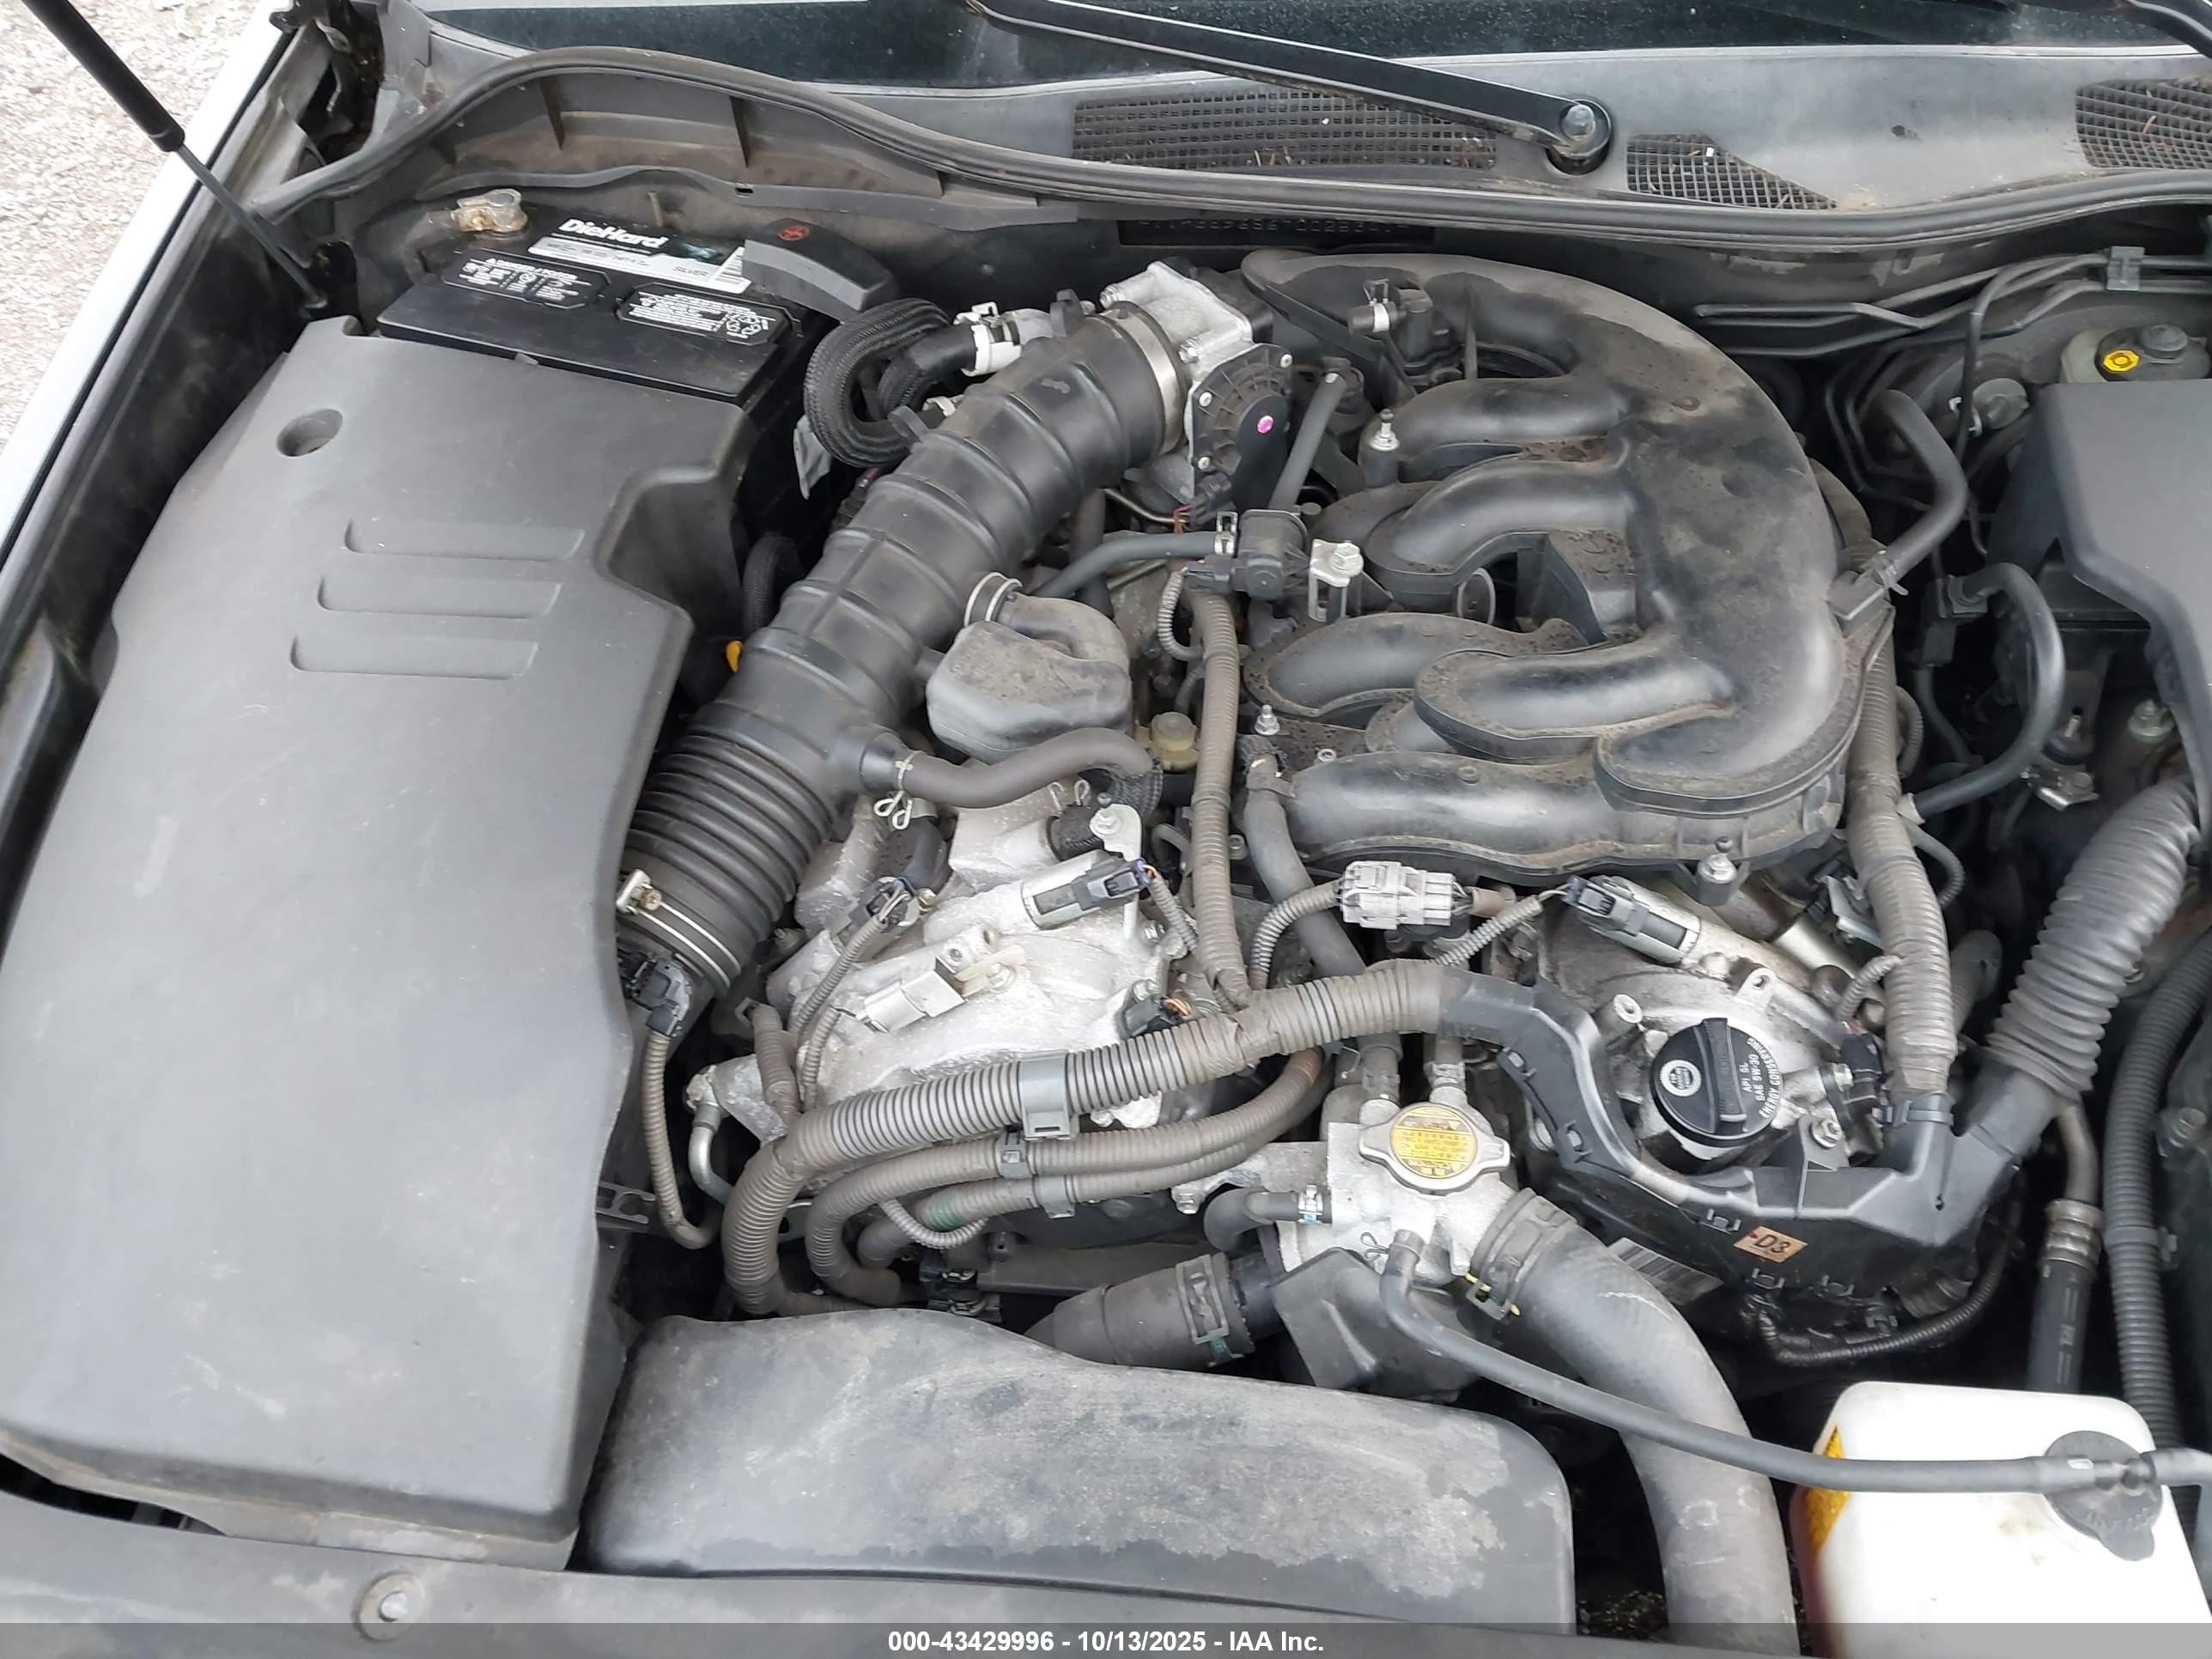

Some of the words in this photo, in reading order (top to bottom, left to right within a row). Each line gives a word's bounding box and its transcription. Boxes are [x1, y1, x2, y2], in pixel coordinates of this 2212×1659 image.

[558, 218, 670, 249] DieHard
[1738, 1061, 1750, 1073] SL
[1746, 1037, 1780, 1085] CONSERVING
[1747, 1054, 1762, 1081] 5W-30
[1741, 1078, 1753, 1093] API
[1753, 1084, 1765, 1102] SAE
[1759, 1087, 1780, 1118] ENERGY
[1753, 1234, 1790, 1253] D3
